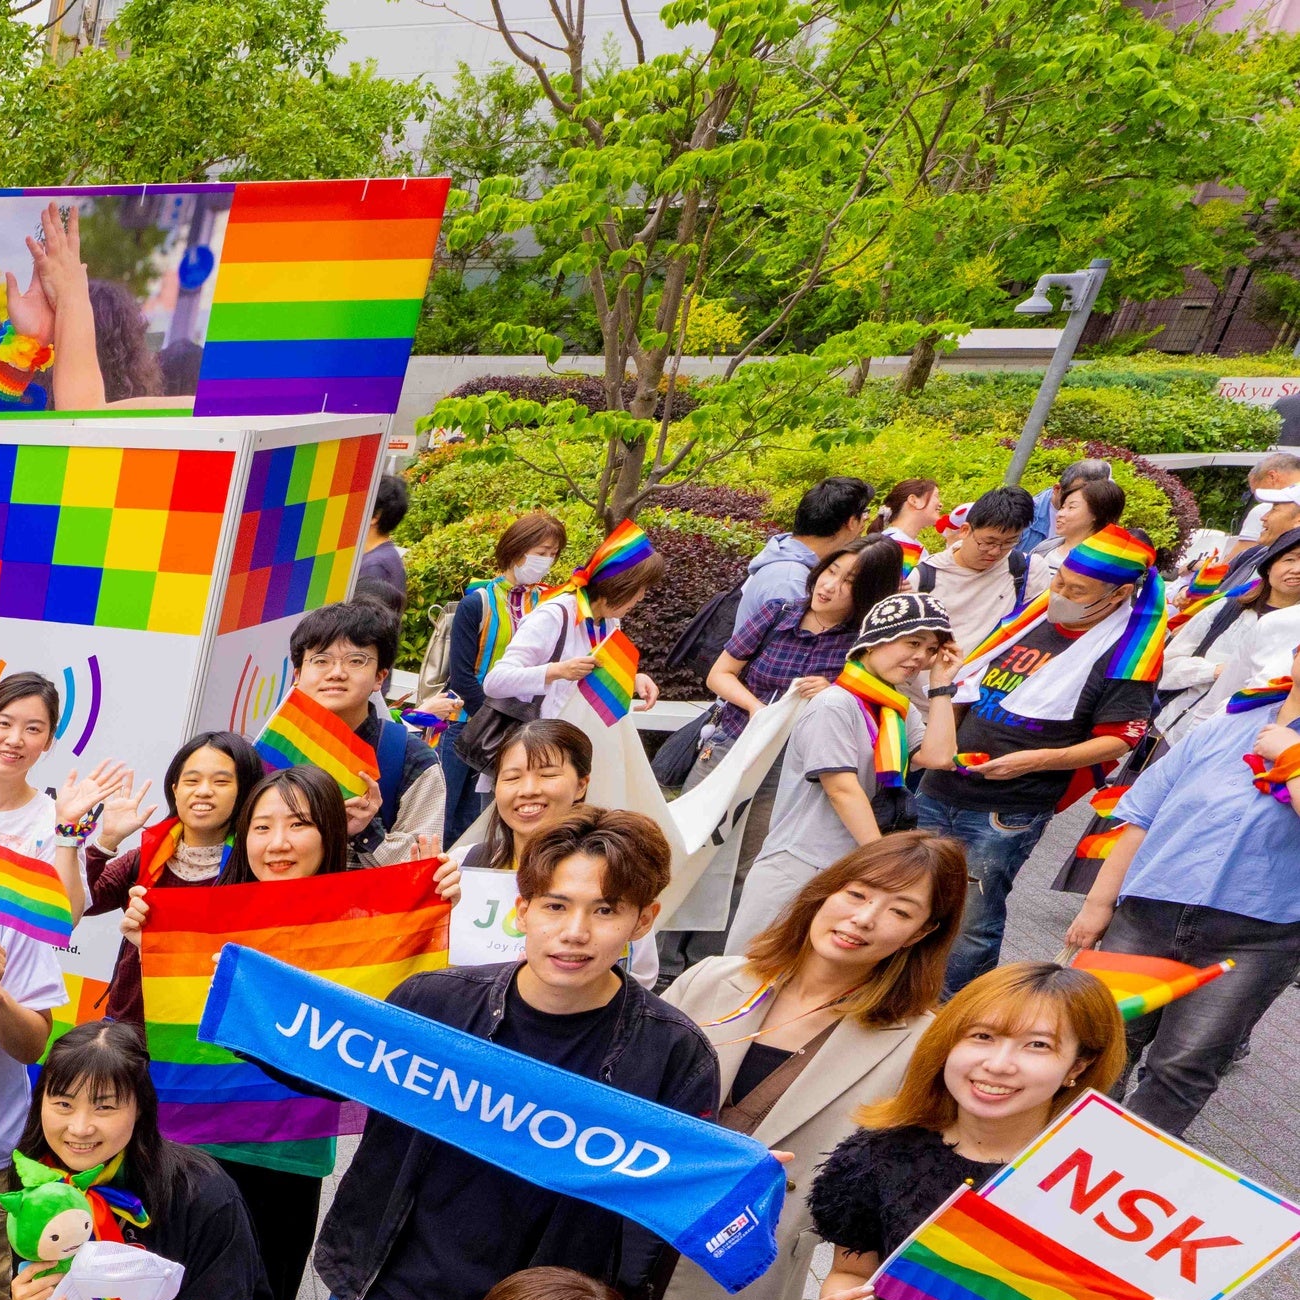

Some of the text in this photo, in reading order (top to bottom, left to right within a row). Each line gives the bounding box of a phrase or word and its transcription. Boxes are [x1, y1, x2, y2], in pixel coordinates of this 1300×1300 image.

[1218, 383, 1273, 400] Tokyu
[276, 1002, 671, 1179] JVCKENWOOD
[1038, 1146, 1244, 1285] NSK
